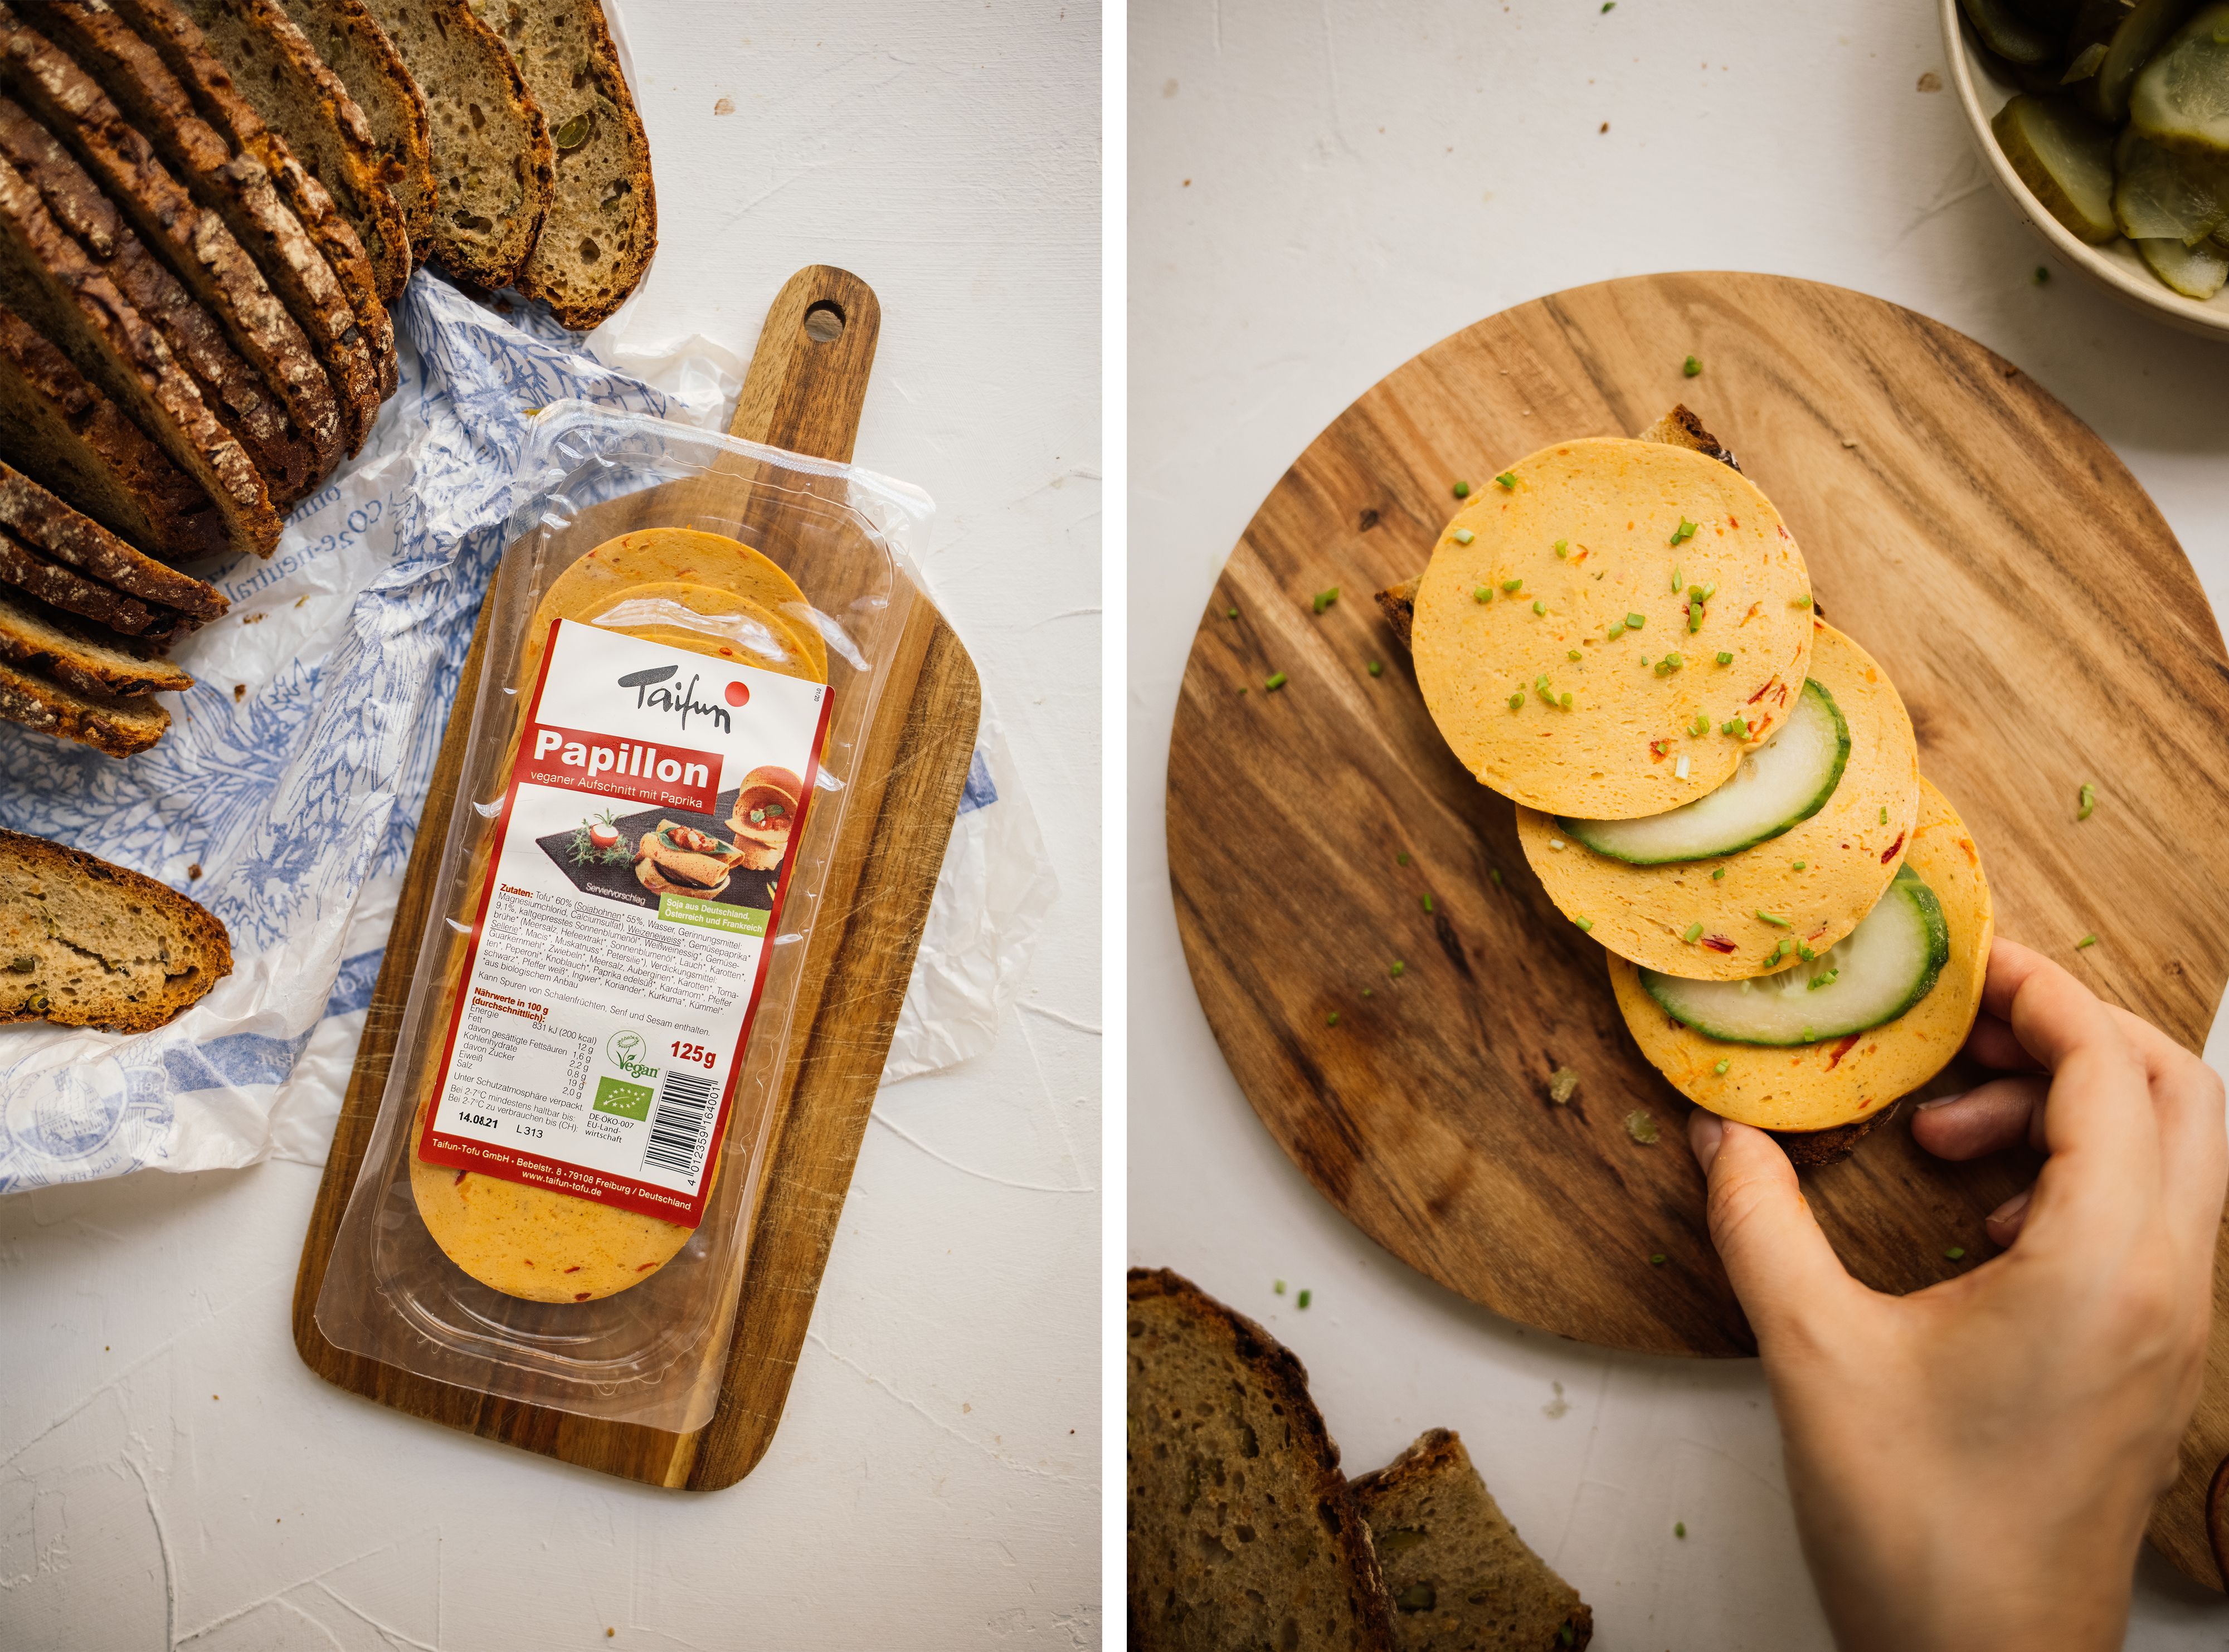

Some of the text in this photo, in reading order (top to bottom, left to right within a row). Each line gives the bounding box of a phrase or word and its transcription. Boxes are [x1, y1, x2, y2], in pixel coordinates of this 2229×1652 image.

[617, 665, 731, 734] Taifun
[814, 688, 822, 702] 01/20
[533, 729, 709, 788] Papillon
[531, 772, 703, 808] veganer Aufschnitt mit Paprika
[498, 891, 568, 918] Magnesiumchlorid,
[571, 910, 625, 932] Calciumsulfat),
[586, 882, 646, 906] Serviervorschlag
[666, 898, 683, 909] Soja
[701, 904, 750, 920] Deutschland,
[500, 883, 533, 898] Zutaten:
[556, 896, 572, 908] 60%
[626, 914, 645, 927] 55%,
[648, 919, 675, 934] Wasser,
[678, 927, 741, 949] Gerinnungsmittel:
[520, 917, 558, 934] (Meersalz,
[665, 907, 762, 933] Österreich und Frankreich
[495, 901, 517, 914] 9,1%,
[519, 907, 573, 928] kaltgepresstes
[705, 954, 739, 969] Gemüse-
[500, 962, 552, 982] biologischem
[552, 976, 578, 988] Anbau
[522, 957, 547, 970] Pfeffer
[589, 954, 625, 972] Meersalz,
[717, 986, 739, 999] Toma-
[651, 960, 717, 983] Verdickungsmittel:
[474, 987, 549, 1016] Nährwerte in 100 g
[478, 971, 710, 1036] Kann Spuren von Schalenfrüchten, Senf und Sesam enthalten.
[593, 966, 621, 980] Paprika
[708, 995, 732, 1007] Pfeffer
[469, 1003, 597, 1046] Energie 831 kJ (200 kcal)
[471, 996, 546, 1024] (durchschnittlich):
[463, 1031, 518, 1052] Kohlenhydrate
[569, 1060, 582, 1069] 2,2
[468, 1012, 482, 1024] Fett
[578, 1042, 587, 1051] 12
[468, 1023, 490, 1035] davon
[491, 1031, 528, 1045] gesättigte
[529, 1039, 567, 1056] Fettsäuren
[573, 1051, 585, 1060] 1,6
[456, 1059, 473, 1069] Salz
[562, 1086, 575, 1096] 2,0
[459, 1050, 585, 1090] Eiweiß 19 g
[463, 1041, 587, 1082] davon Zucker 0,8 g
[615, 1050, 658, 1079] Vegan
[450, 1084, 463, 1093] Bei
[488, 1095, 532, 1110] mindestens
[533, 1104, 560, 1118] haltbar
[562, 1112, 576, 1122] bis:
[454, 1072, 584, 1111] Unter Schutzatmosphäre verpackt.
[448, 1093, 460, 1103] Bei
[498, 1107, 544, 1123] verbrauchen
[546, 1117, 557, 1127] bis
[558, 1120, 578, 1133] (CH):
[459, 1112, 498, 1129] 14.08.21
[587, 1120, 621, 1134] EU-Land-
[589, 1113, 634, 1129] DE-ÖKO-007
[585, 1130, 622, 1143] wirtschaft
[432, 1138, 480, 1156] Taifun-Tofu
[482, 1149, 509, 1163] GmbH
[517, 1158, 553, 1173] Bebelstr.
[568, 1171, 593, 1183] 79108
[595, 1177, 631, 1195] Freiburg
[638, 1188, 691, 1210] Deutschland
[522, 1171, 602, 1196] www.taifun-tofu.de
[687, 1178, 696, 1187] 4
